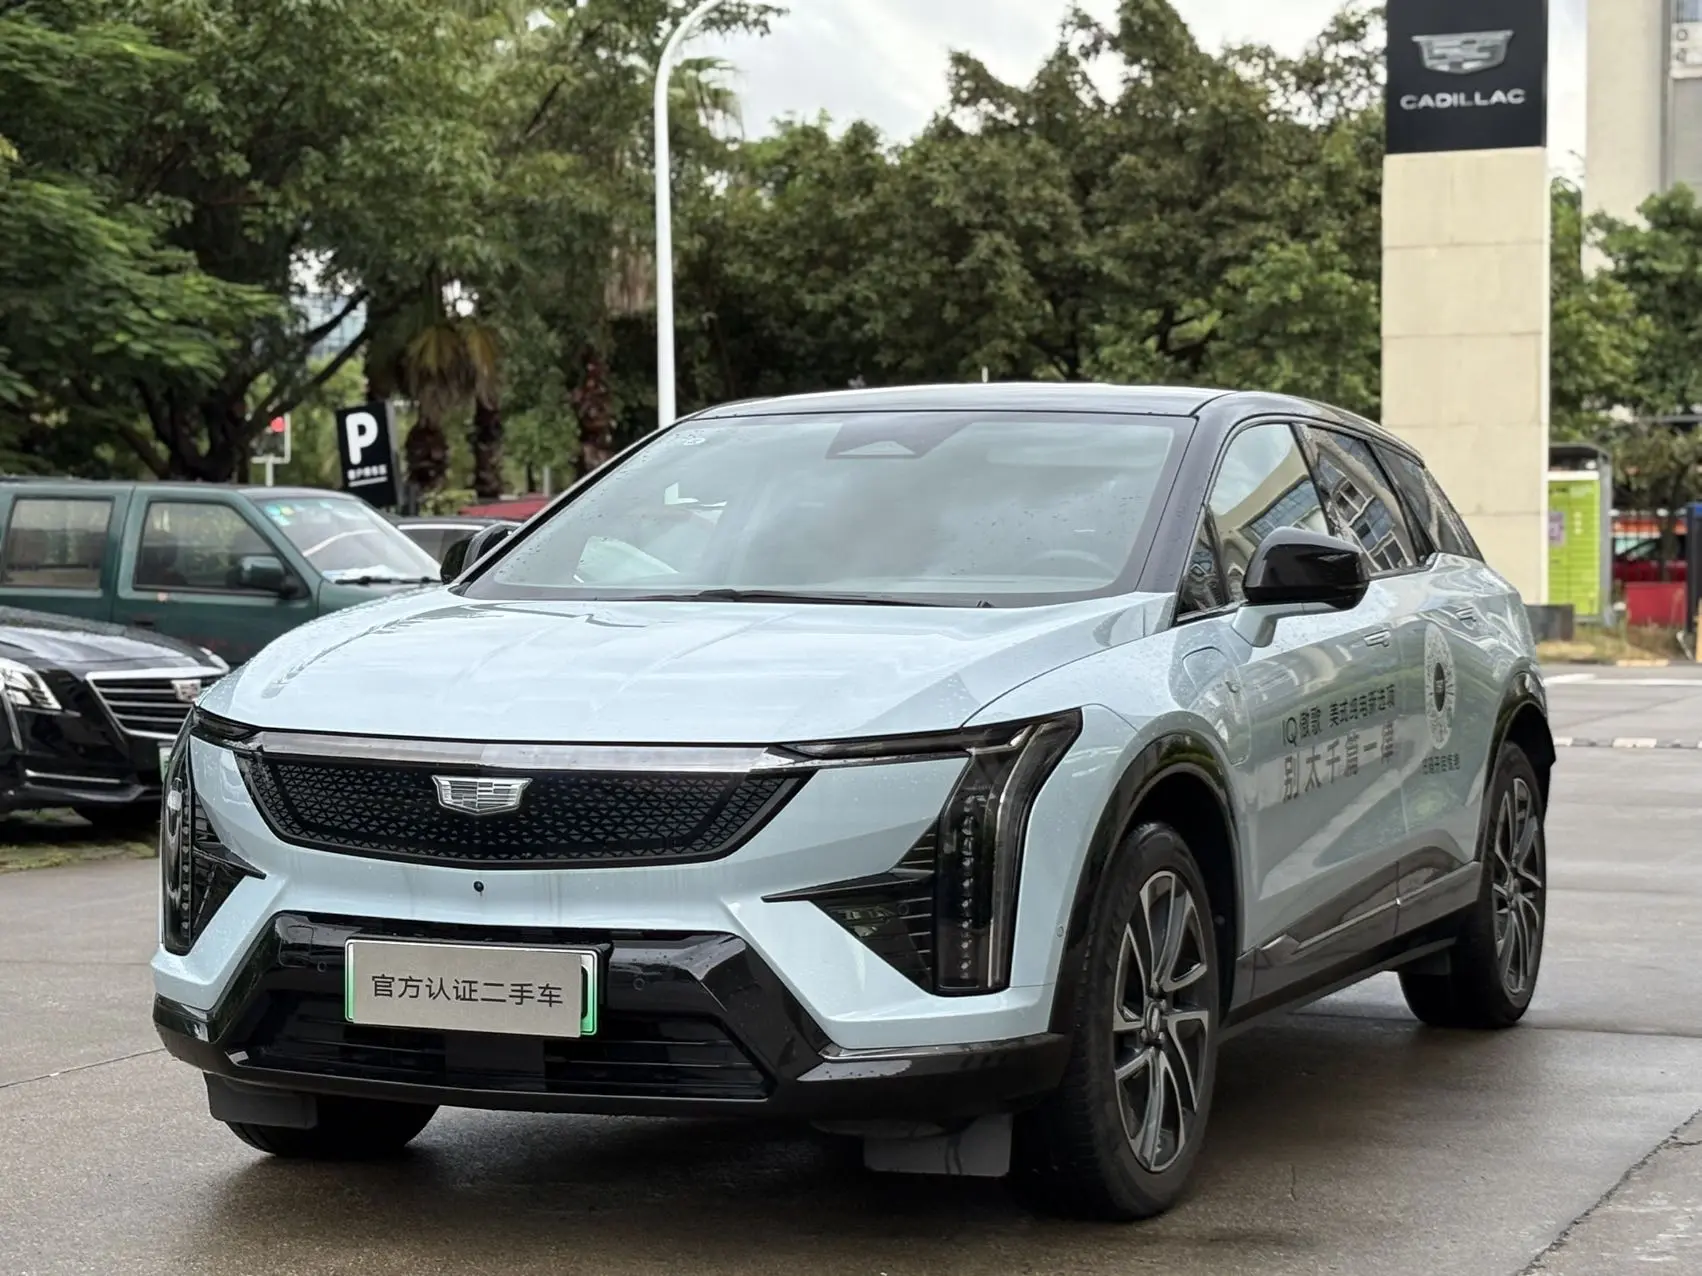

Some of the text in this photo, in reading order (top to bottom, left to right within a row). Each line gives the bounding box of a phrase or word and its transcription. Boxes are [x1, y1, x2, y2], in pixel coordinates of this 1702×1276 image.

[1400, 88, 1525, 110] CADILLAC
[345, 412, 378, 465] P
[1283, 720, 1394, 803] 别太千篇一律
[372, 973, 563, 1007] 官方认证二手车
